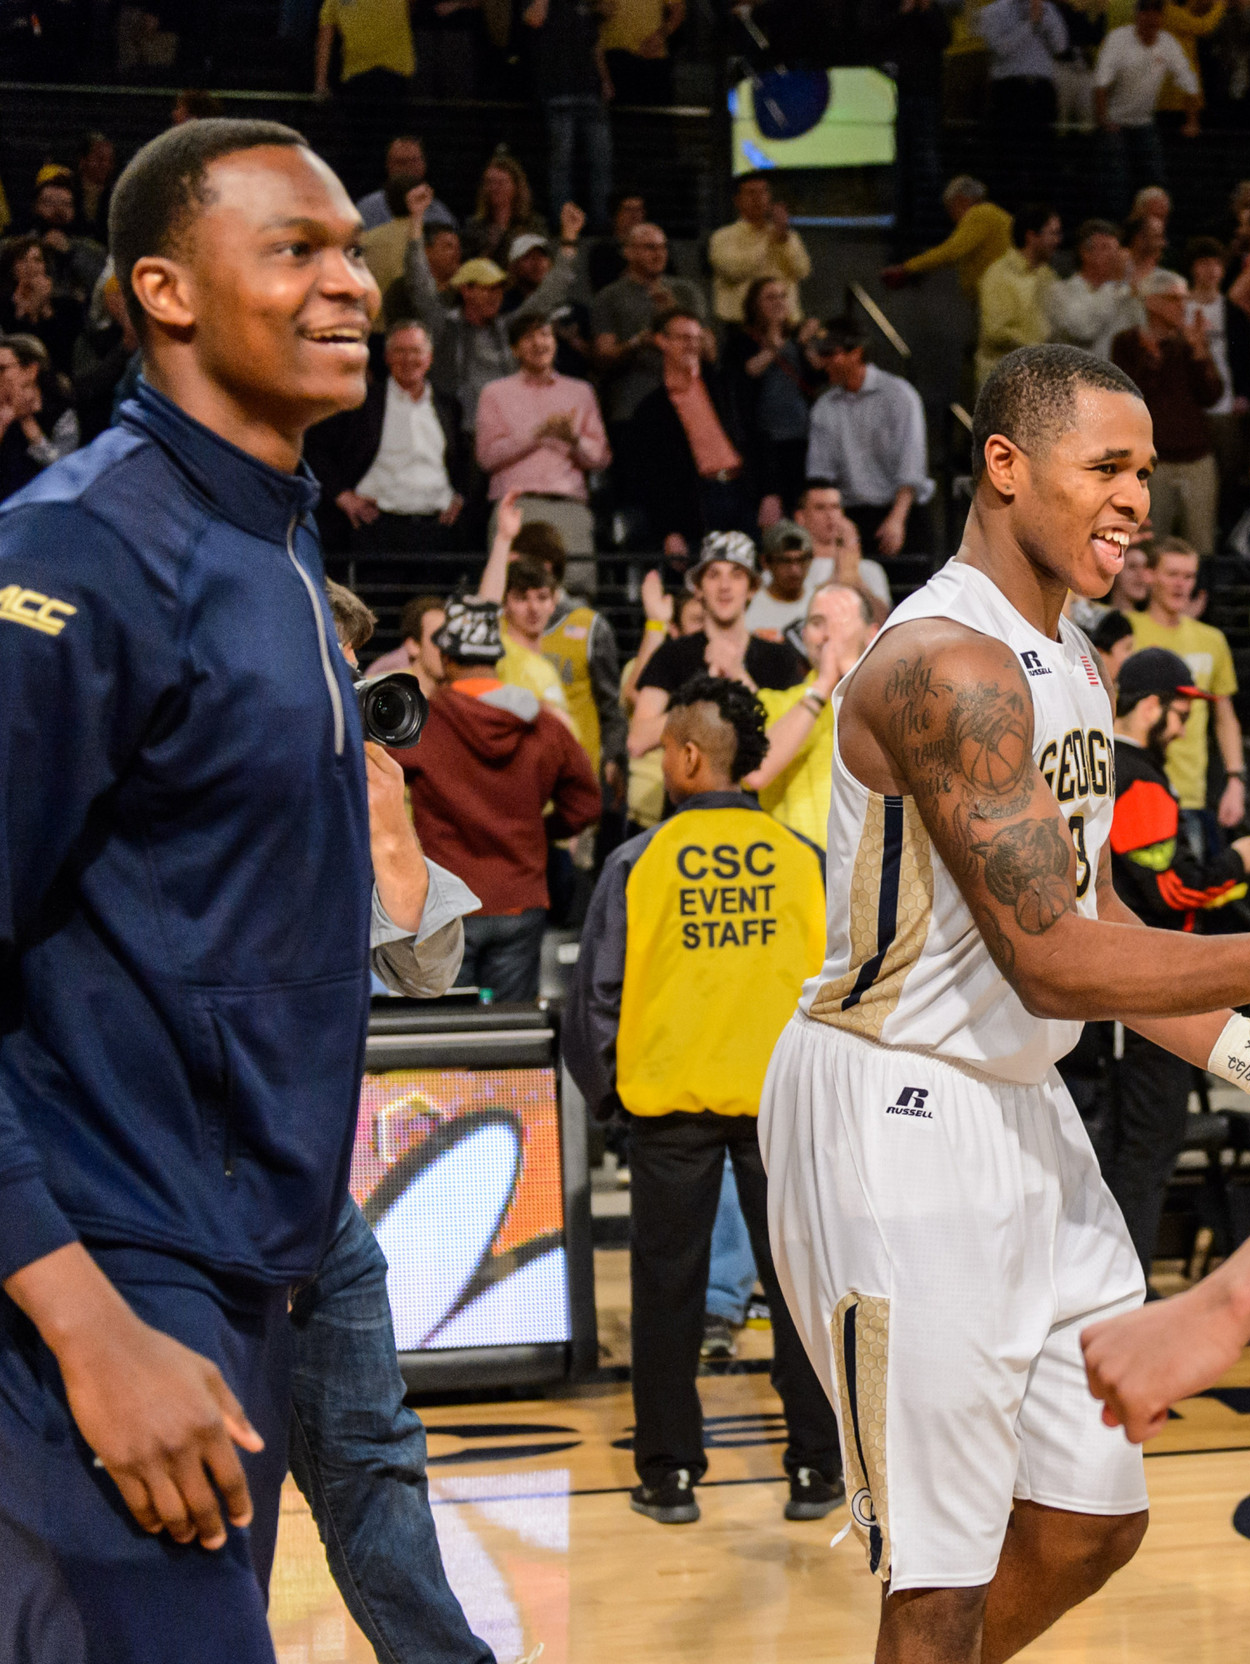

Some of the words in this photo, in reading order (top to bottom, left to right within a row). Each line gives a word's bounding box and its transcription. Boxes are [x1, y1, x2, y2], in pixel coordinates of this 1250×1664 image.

[676, 841, 775, 881] CSC
[679, 884, 776, 916] EVENT
[682, 919, 777, 949] STAFF
[886, 1106, 933, 1119] RUSSELL
